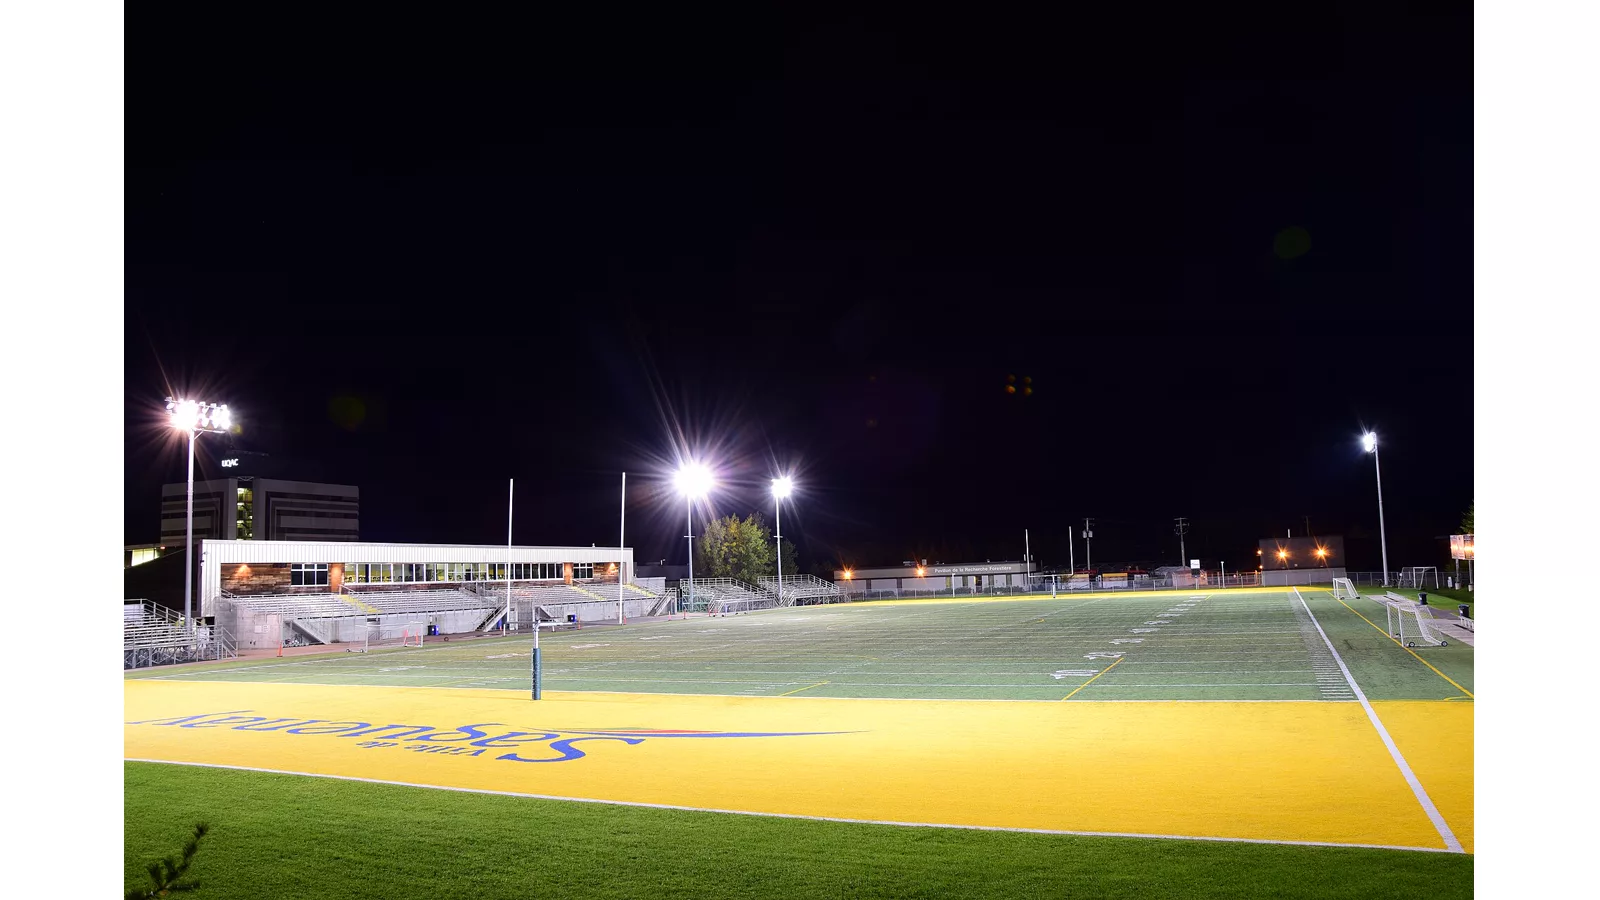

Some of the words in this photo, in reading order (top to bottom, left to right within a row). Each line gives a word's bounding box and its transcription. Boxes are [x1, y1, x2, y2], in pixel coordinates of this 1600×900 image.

[221, 458, 239, 468] UQAC
[125, 710, 645, 762] Saguenay
[356, 741, 398, 749] de
[404, 743, 487, 757] Ville
